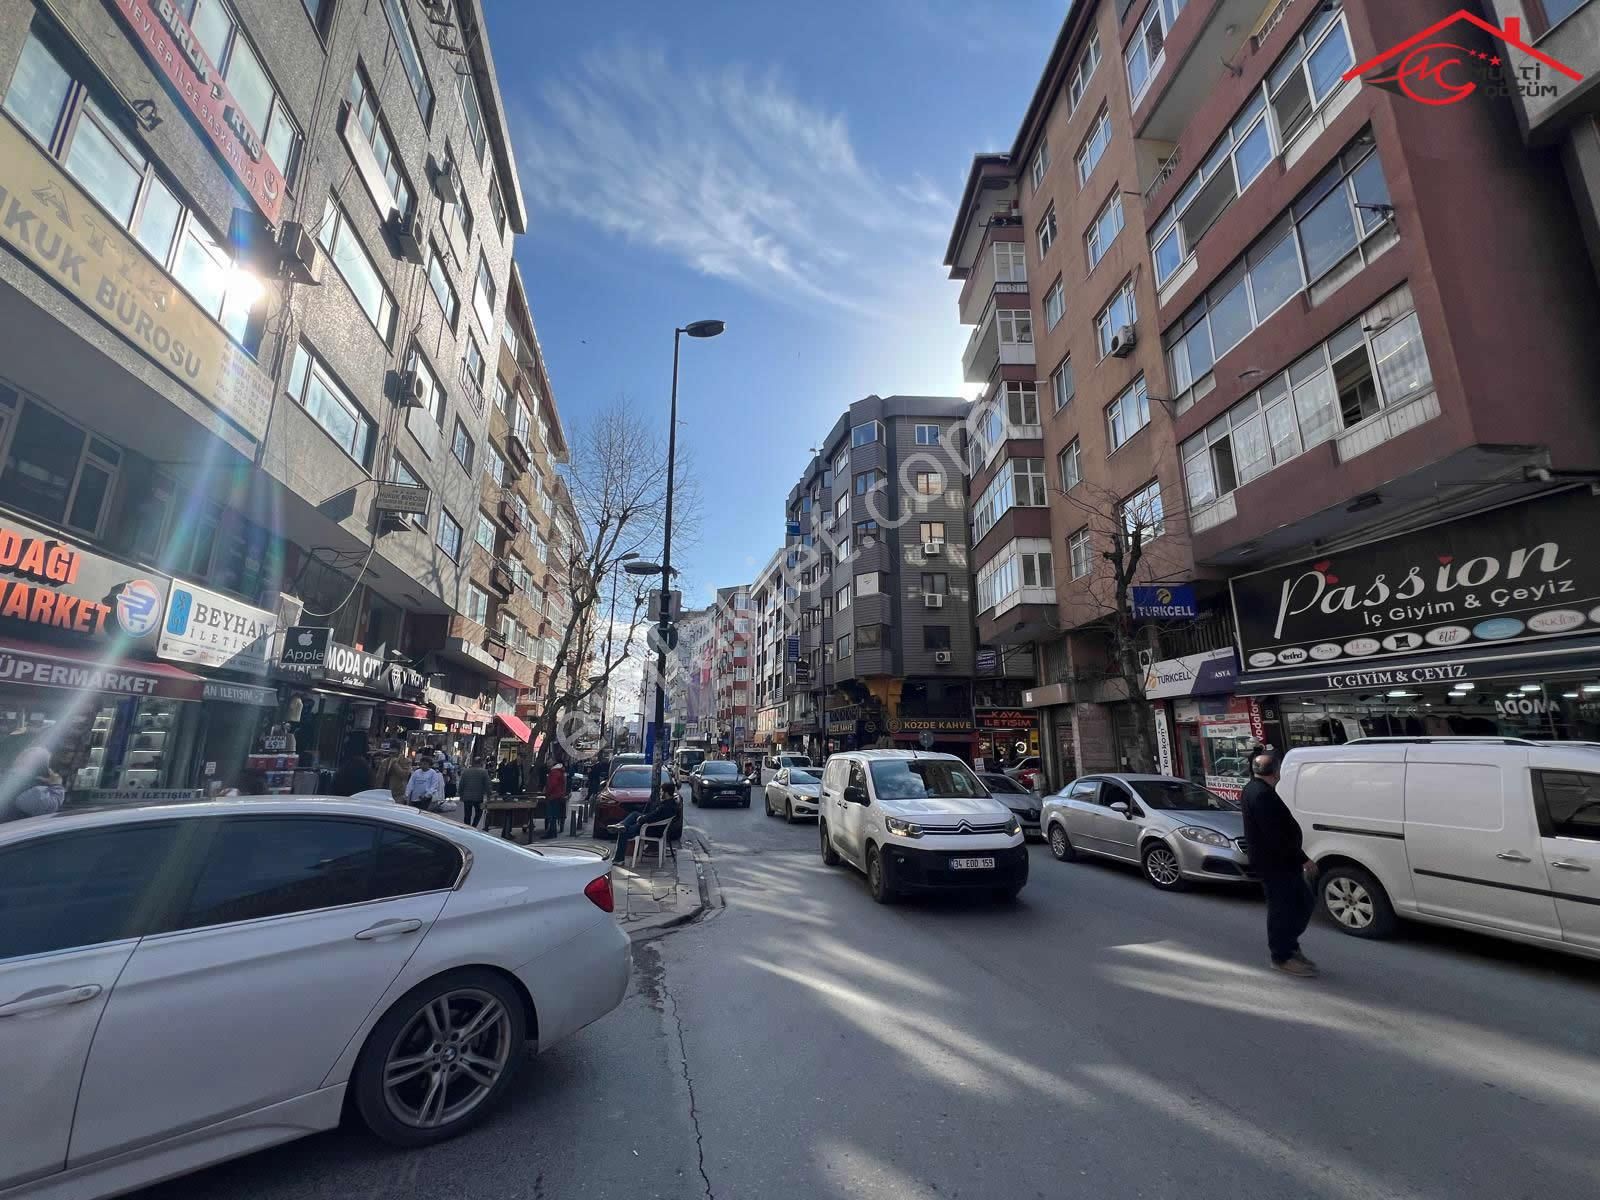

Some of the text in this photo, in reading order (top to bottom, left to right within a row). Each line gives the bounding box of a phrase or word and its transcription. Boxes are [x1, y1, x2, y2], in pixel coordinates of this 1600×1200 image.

[95, 274, 202, 380] BÜROSU
[1273, 542, 1571, 639] Passion
[1363, 579, 1576, 626] İç Giyim & Çeyiz
[193, 602, 270, 642] BEYHAN
[284, 648, 324, 662] Apple
[325, 646, 384, 681] MODA CITY
[1327, 665, 1467, 689] İÇ GİYİM & ÇEYİZ
[904, 719, 971, 729] KÖZDE KAHVE
[1160, 728, 1169, 769] Telekom
[954, 859, 962, 868] 34
[983, 858, 993, 867] 159
